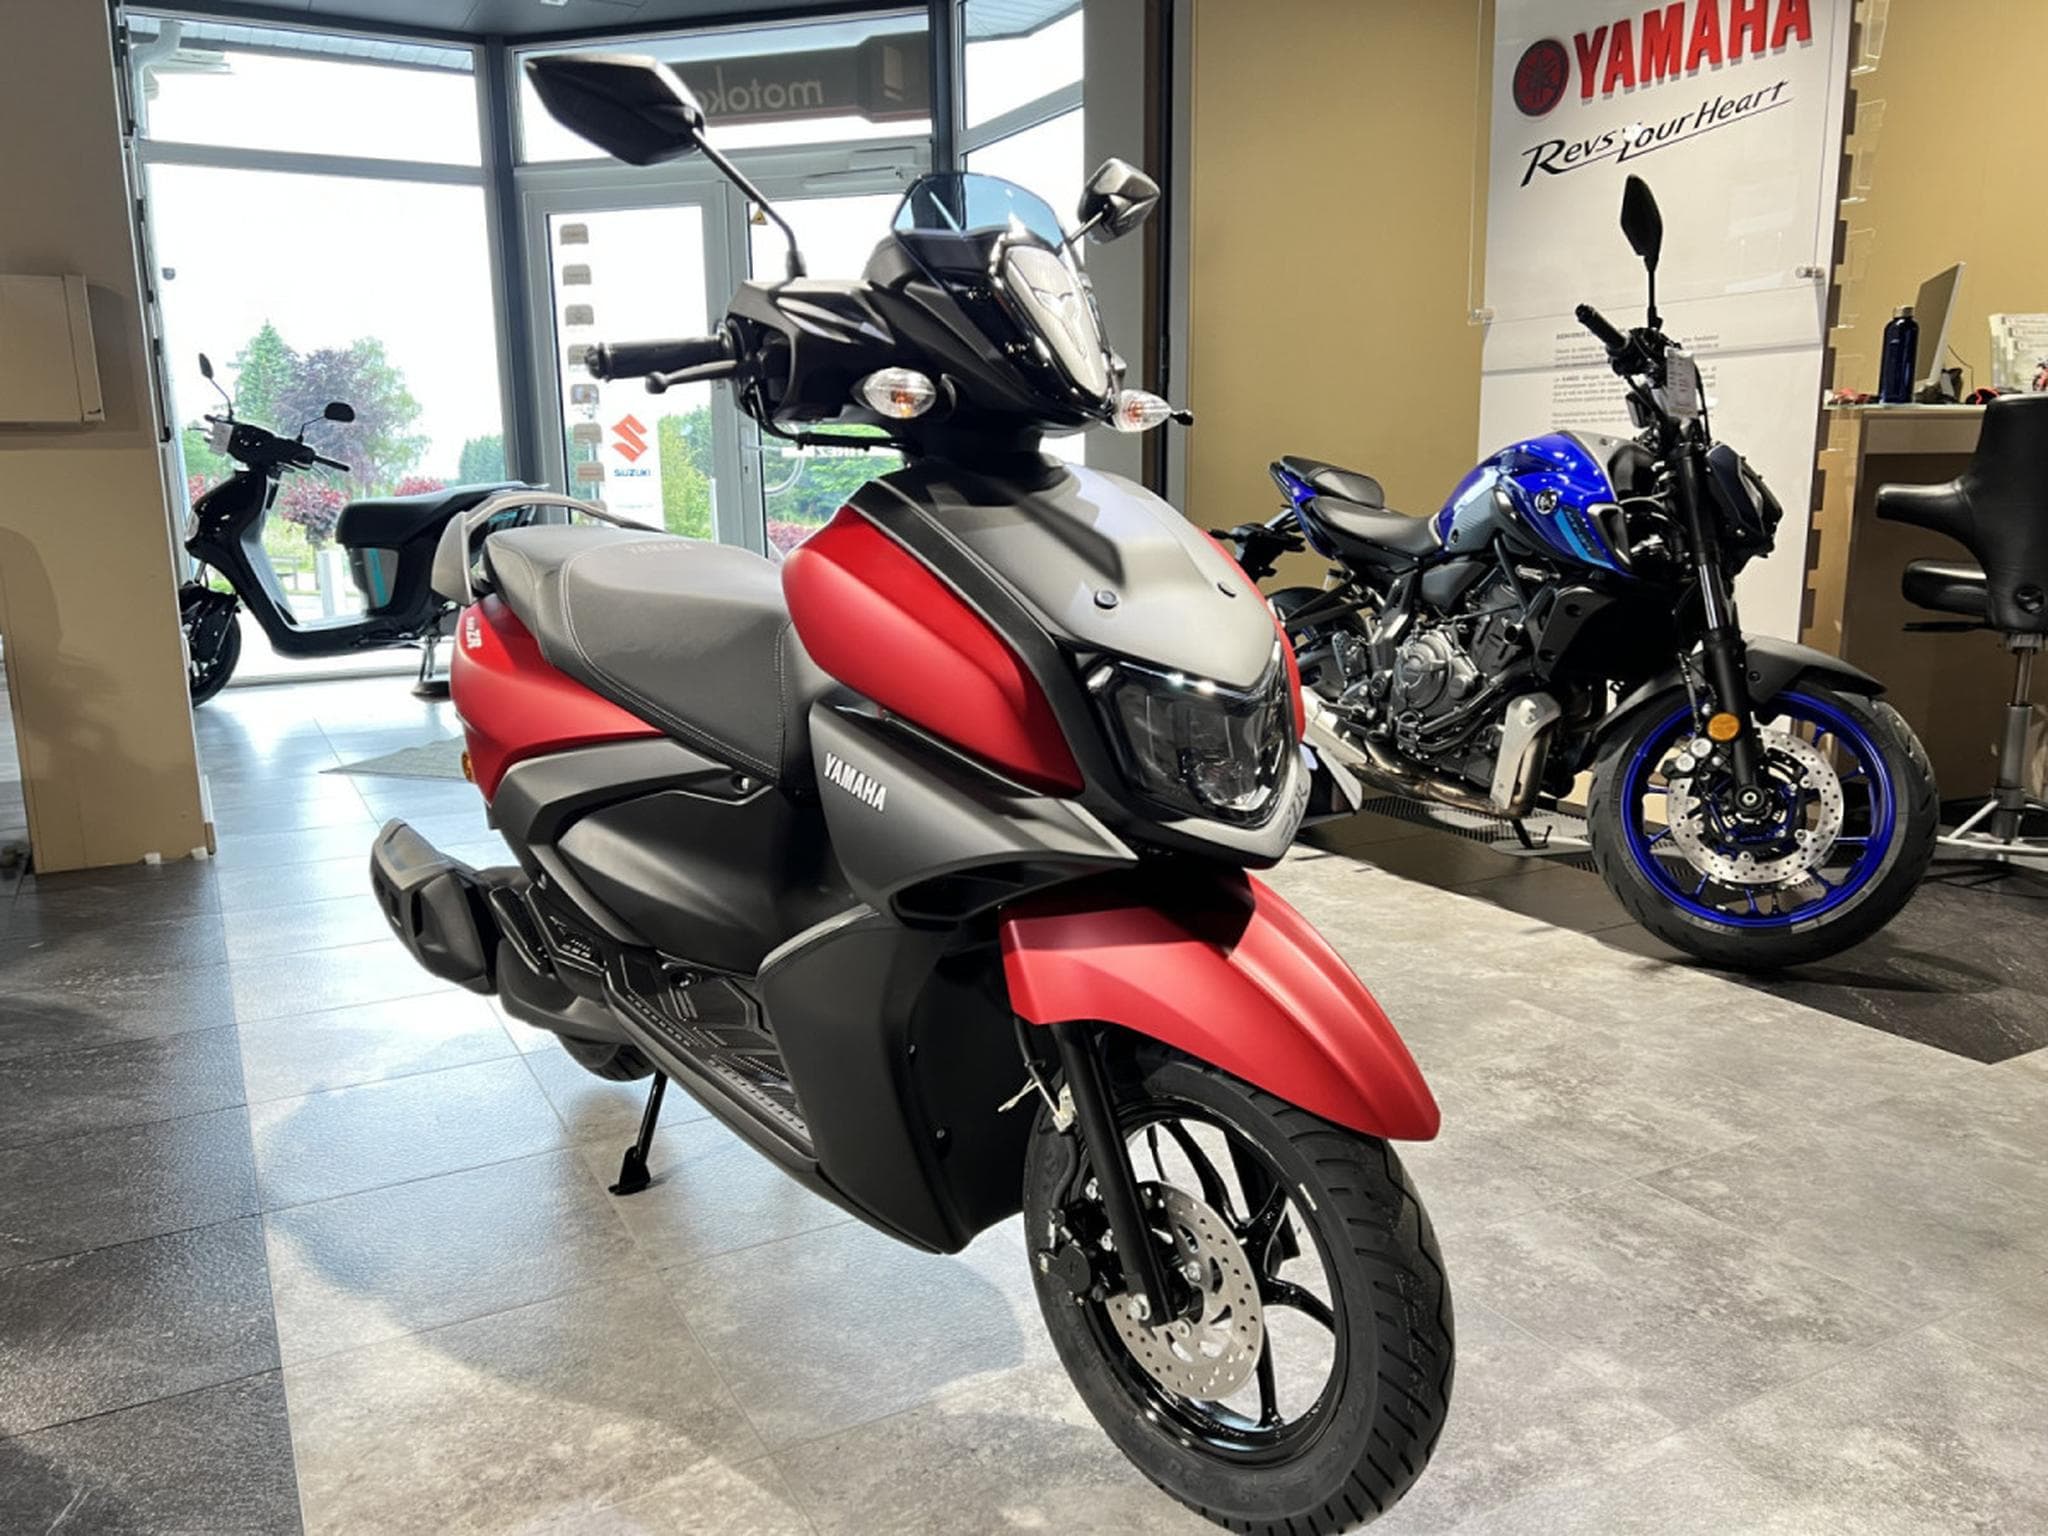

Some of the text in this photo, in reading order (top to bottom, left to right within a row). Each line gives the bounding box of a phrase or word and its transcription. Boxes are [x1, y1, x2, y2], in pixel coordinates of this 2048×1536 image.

[1574, 0, 1812, 101] YAMAHA
[1520, 130, 1617, 188] Revs
[1693, 79, 1790, 130] Heart
[613, 468, 651, 478] SUZUKI
[823, 752, 887, 812] YAMAHA
